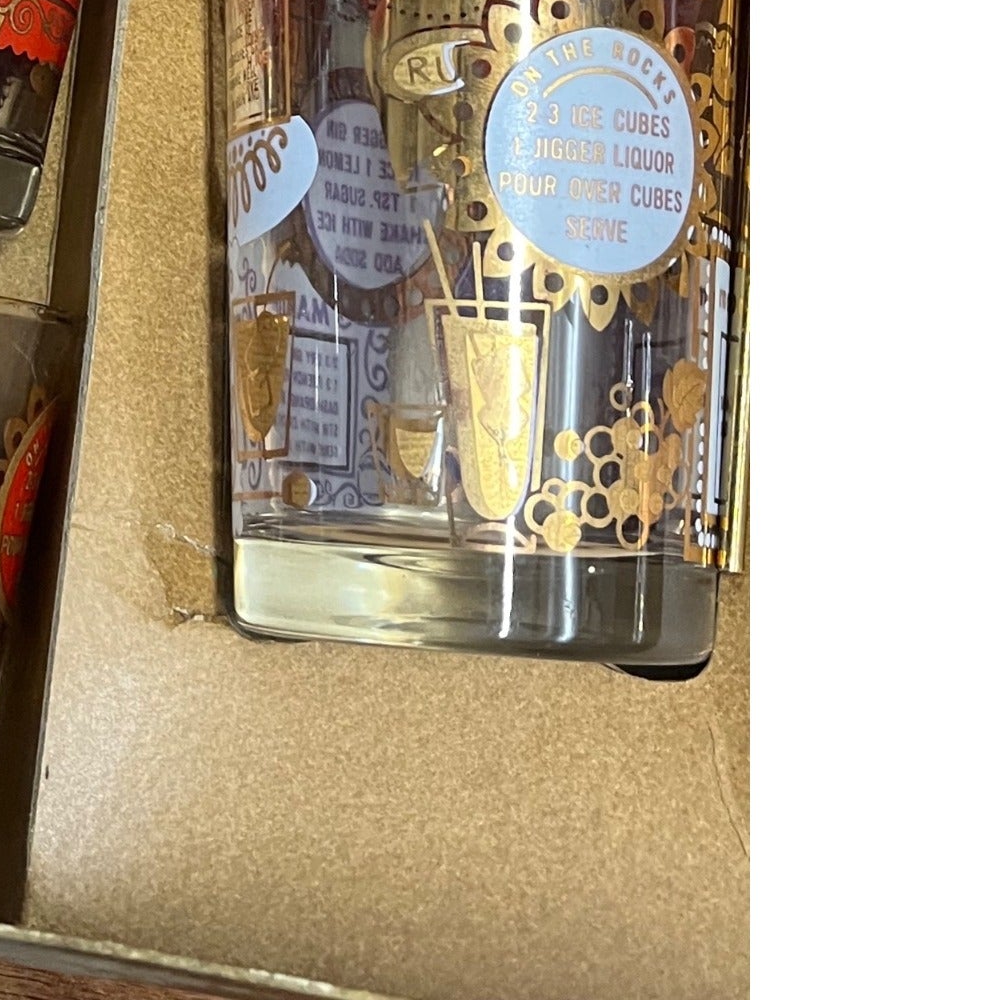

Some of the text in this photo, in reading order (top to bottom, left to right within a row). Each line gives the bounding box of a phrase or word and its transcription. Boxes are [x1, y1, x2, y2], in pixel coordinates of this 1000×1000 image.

[511, 39, 676, 104] ON THE ROCKS
[526, 101, 670, 138] 2 3 ICE CUBES
[534, 137, 606, 164] JIGGER
[613, 144, 674, 174] LIQUOR
[499, 172, 682, 213] POUR OVER CUBES
[565, 215, 628, 243] SERVE
